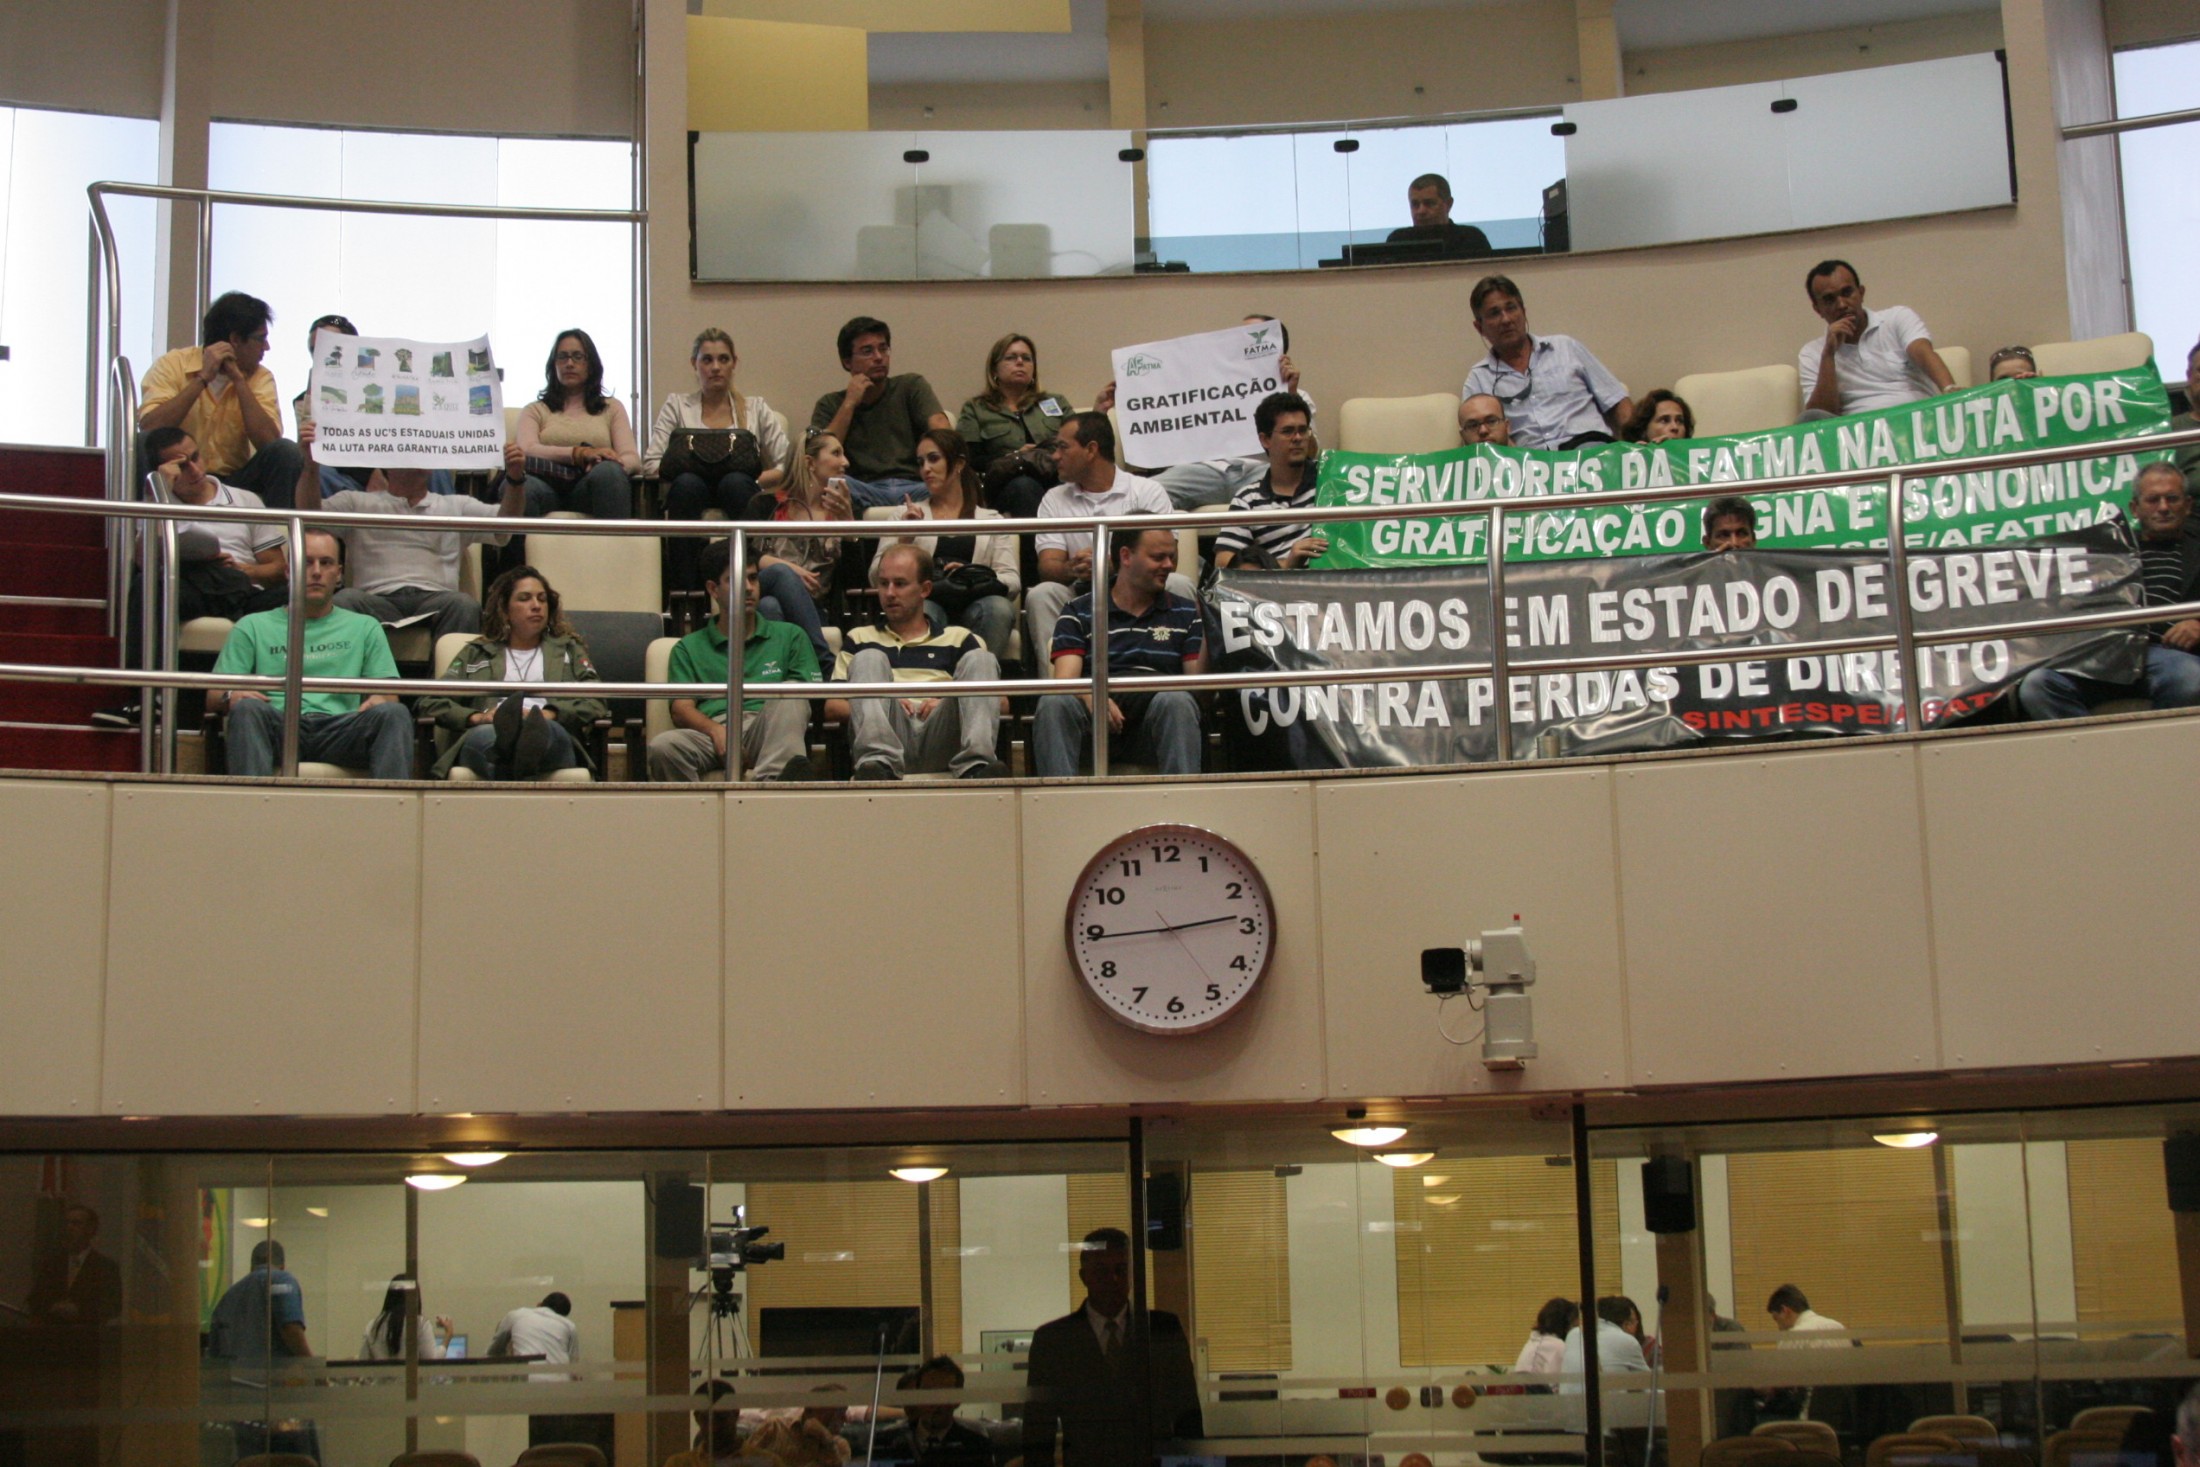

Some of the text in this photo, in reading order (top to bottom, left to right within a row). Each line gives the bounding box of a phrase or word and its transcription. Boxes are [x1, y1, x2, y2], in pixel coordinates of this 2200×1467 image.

[1244, 342, 1277, 355] FATMA
[1127, 377, 1277, 411] GRATIFICAÇÃO
[1129, 408, 1247, 435] AMBIENTAL
[322, 426, 495, 439] TODAS AS UC'S ESTADUAIS UNIDAS
[322, 443, 500, 454] NA LUTA PARA GARANTIA SALARIAL
[1345, 380, 2127, 505] SERVIDORES DA FATMA NA LUTA POR
[1849, 486, 1874, 530] E
[1220, 547, 2093, 653] ESTAMOS EM ESTADO DE GREVE
[310, 641, 351, 653] LOOSE
[1241, 639, 2009, 736] CONTRA PERDAS DE DIREITO
[1151, 845, 1181, 862] 12
[1120, 860, 1141, 876] 11
[1198, 856, 1208, 873] 1
[1095, 887, 1125, 905] 10
[1225, 882, 1242, 899] 2
[1086, 925, 1105, 941] 9
[1239, 917, 1256, 935] 3
[1101, 961, 1117, 978] 8
[1229, 955, 1247, 971] 4
[1132, 987, 1149, 1003] 7
[1205, 984, 1221, 1001] 5
[1166, 996, 1185, 1013] 6
